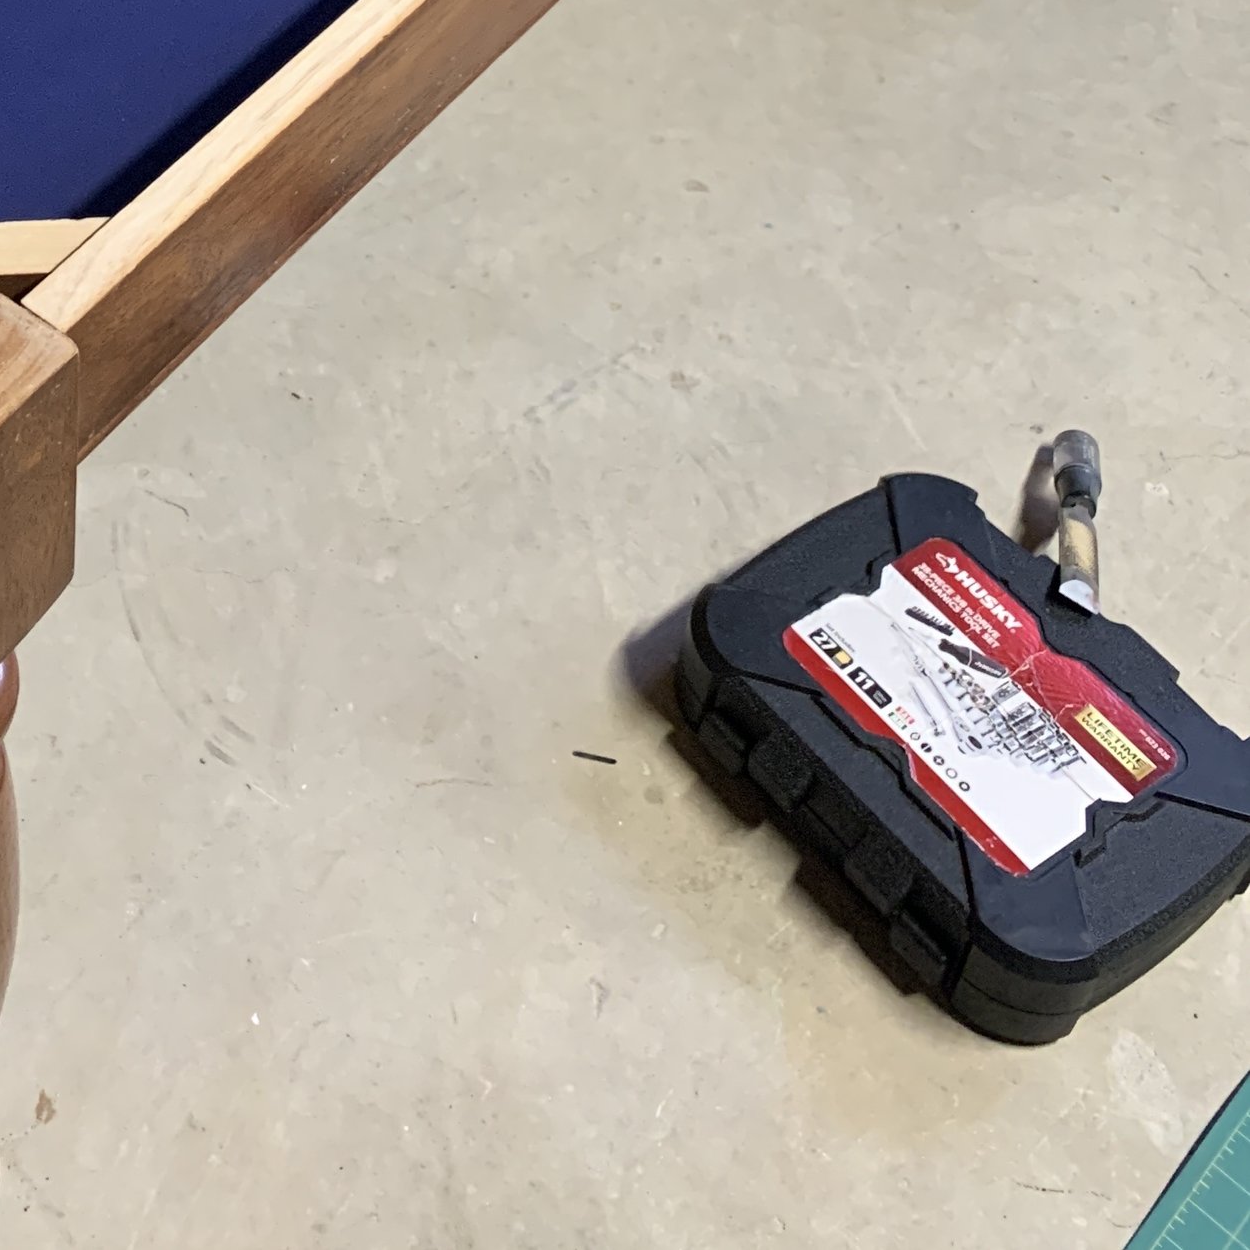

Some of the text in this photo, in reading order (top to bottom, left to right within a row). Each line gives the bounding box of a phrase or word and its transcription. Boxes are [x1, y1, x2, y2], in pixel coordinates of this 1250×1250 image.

[911, 566, 1000, 648] MECHANICS TOOL SET
[955, 570, 1023, 629] HUSKY
[973, 612, 1001, 639] DRIVE
[812, 631, 838, 650] 27
[854, 671, 875, 690] 11
[1082, 717, 1140, 771] WARRANTY
[1086, 712, 1147, 768] LIFETIME
